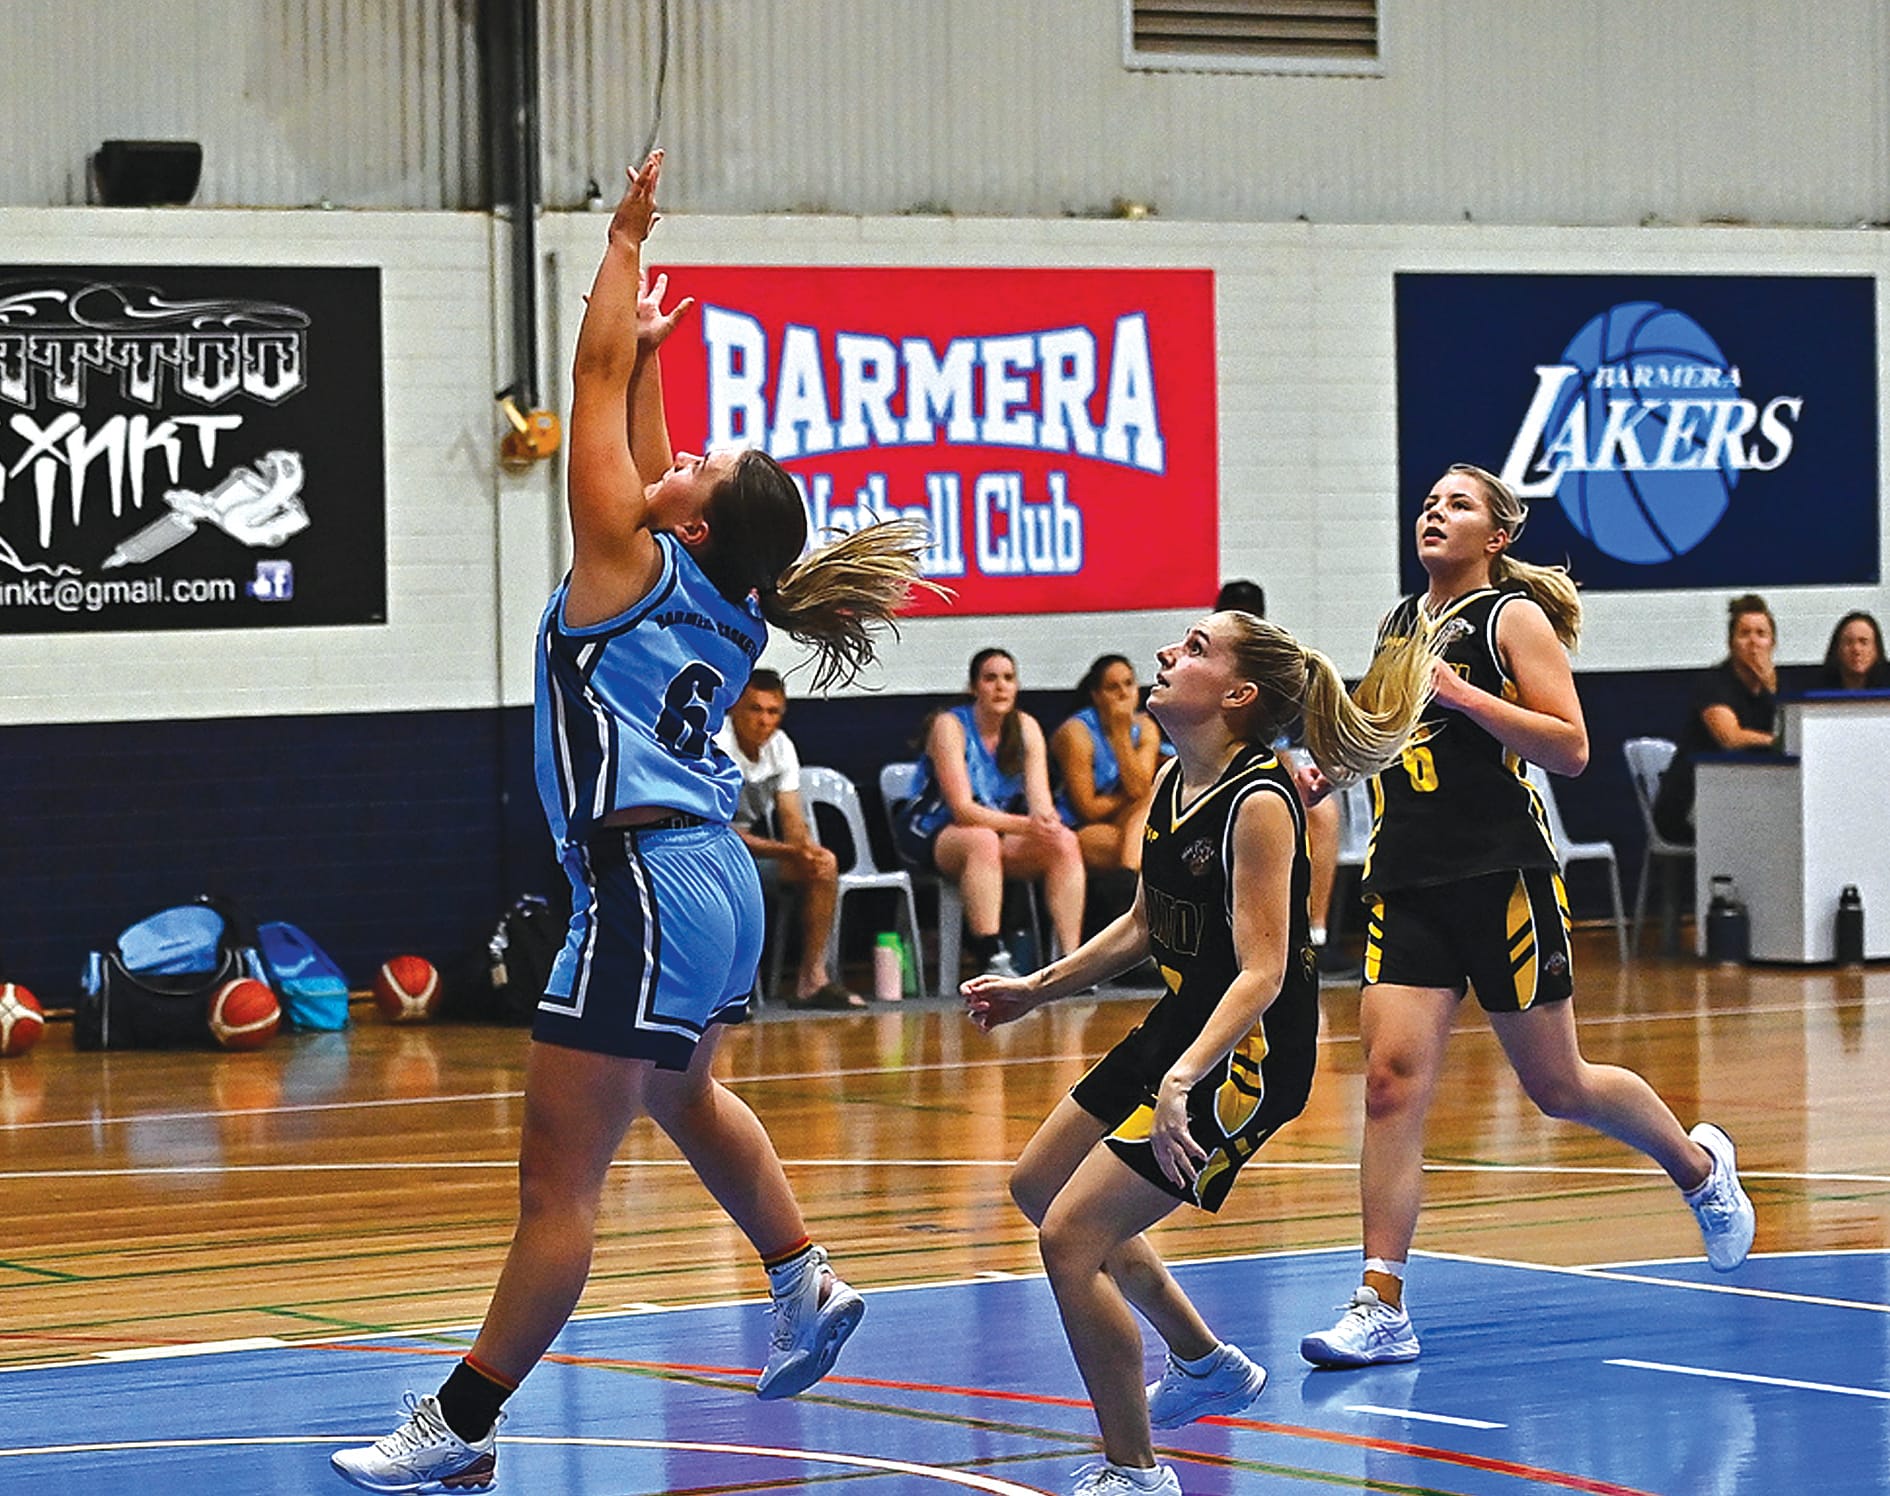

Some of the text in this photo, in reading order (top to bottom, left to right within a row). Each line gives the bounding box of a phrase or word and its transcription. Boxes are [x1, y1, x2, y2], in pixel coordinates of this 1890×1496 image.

[703, 303, 1165, 476] BARMERA
[1501, 365, 1804, 498] LAKERS
[1593, 364, 1742, 388] BARMERA
[974, 471, 1086, 577] Club
